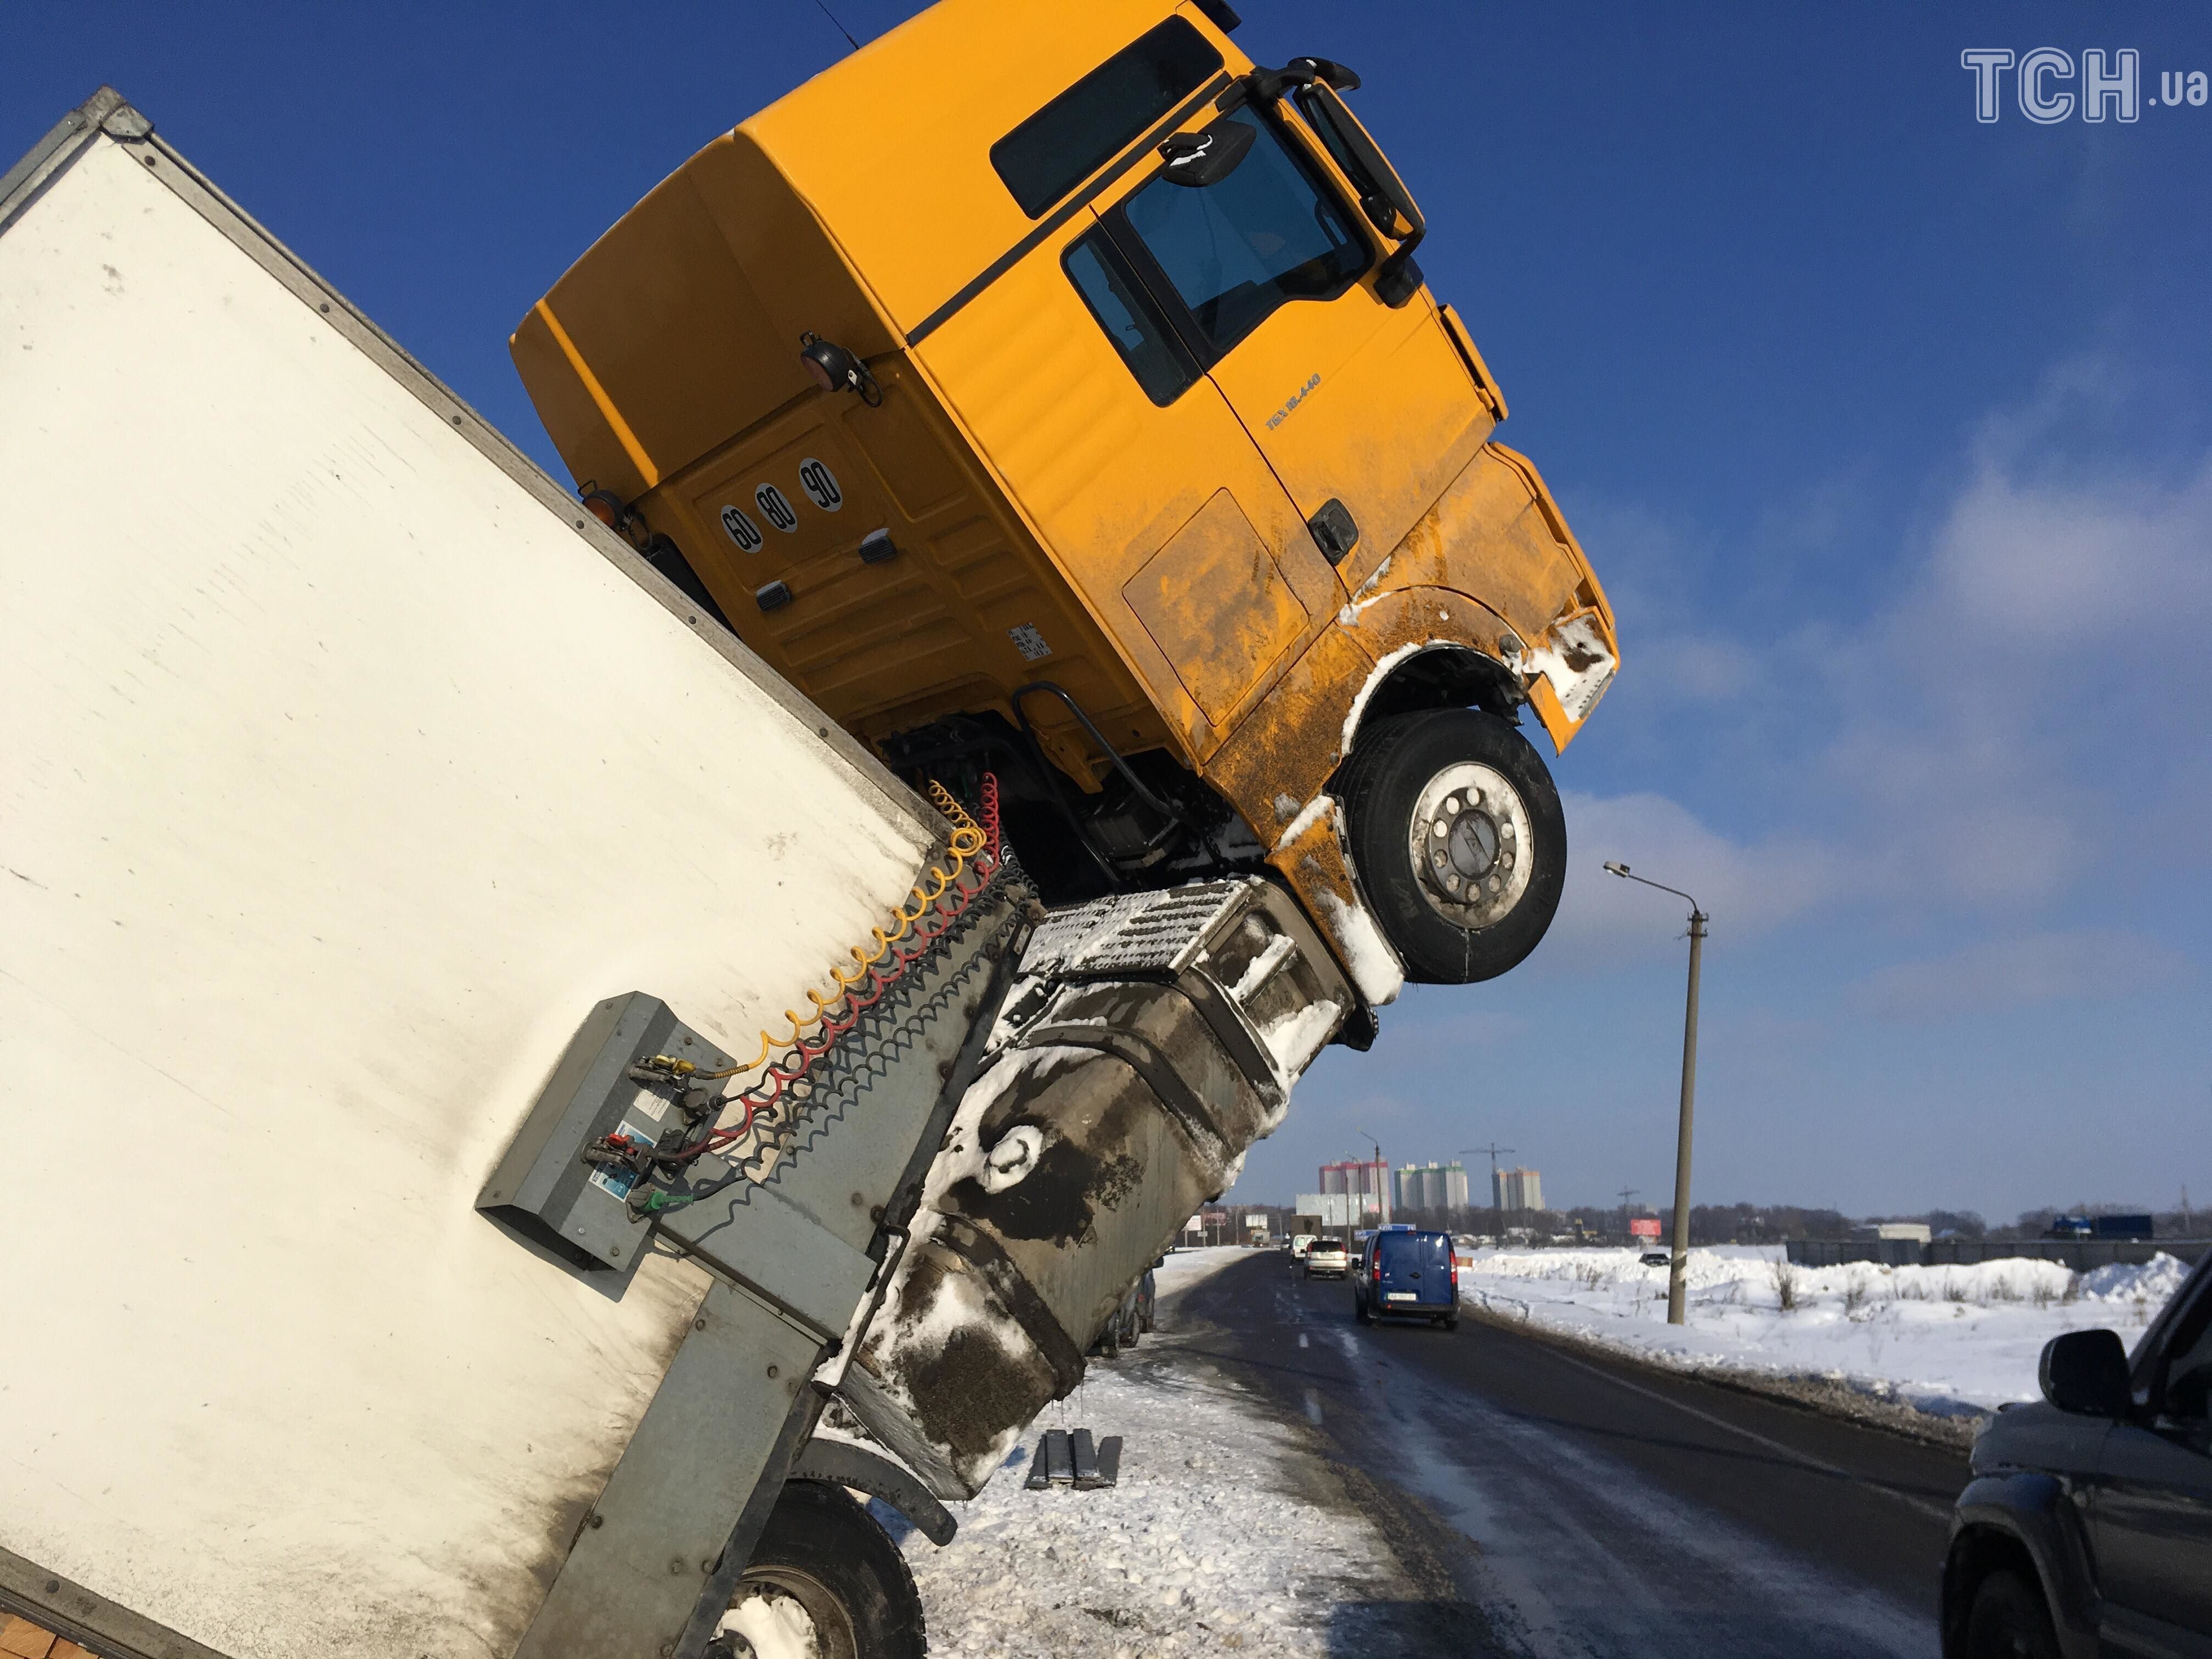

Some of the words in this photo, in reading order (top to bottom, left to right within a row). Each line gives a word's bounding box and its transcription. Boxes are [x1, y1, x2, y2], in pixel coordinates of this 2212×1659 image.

[1265, 408, 1288, 431] TGX
[722, 508, 762, 550] 60
[756, 486, 795, 529] 80
[800, 461, 841, 508] 90
